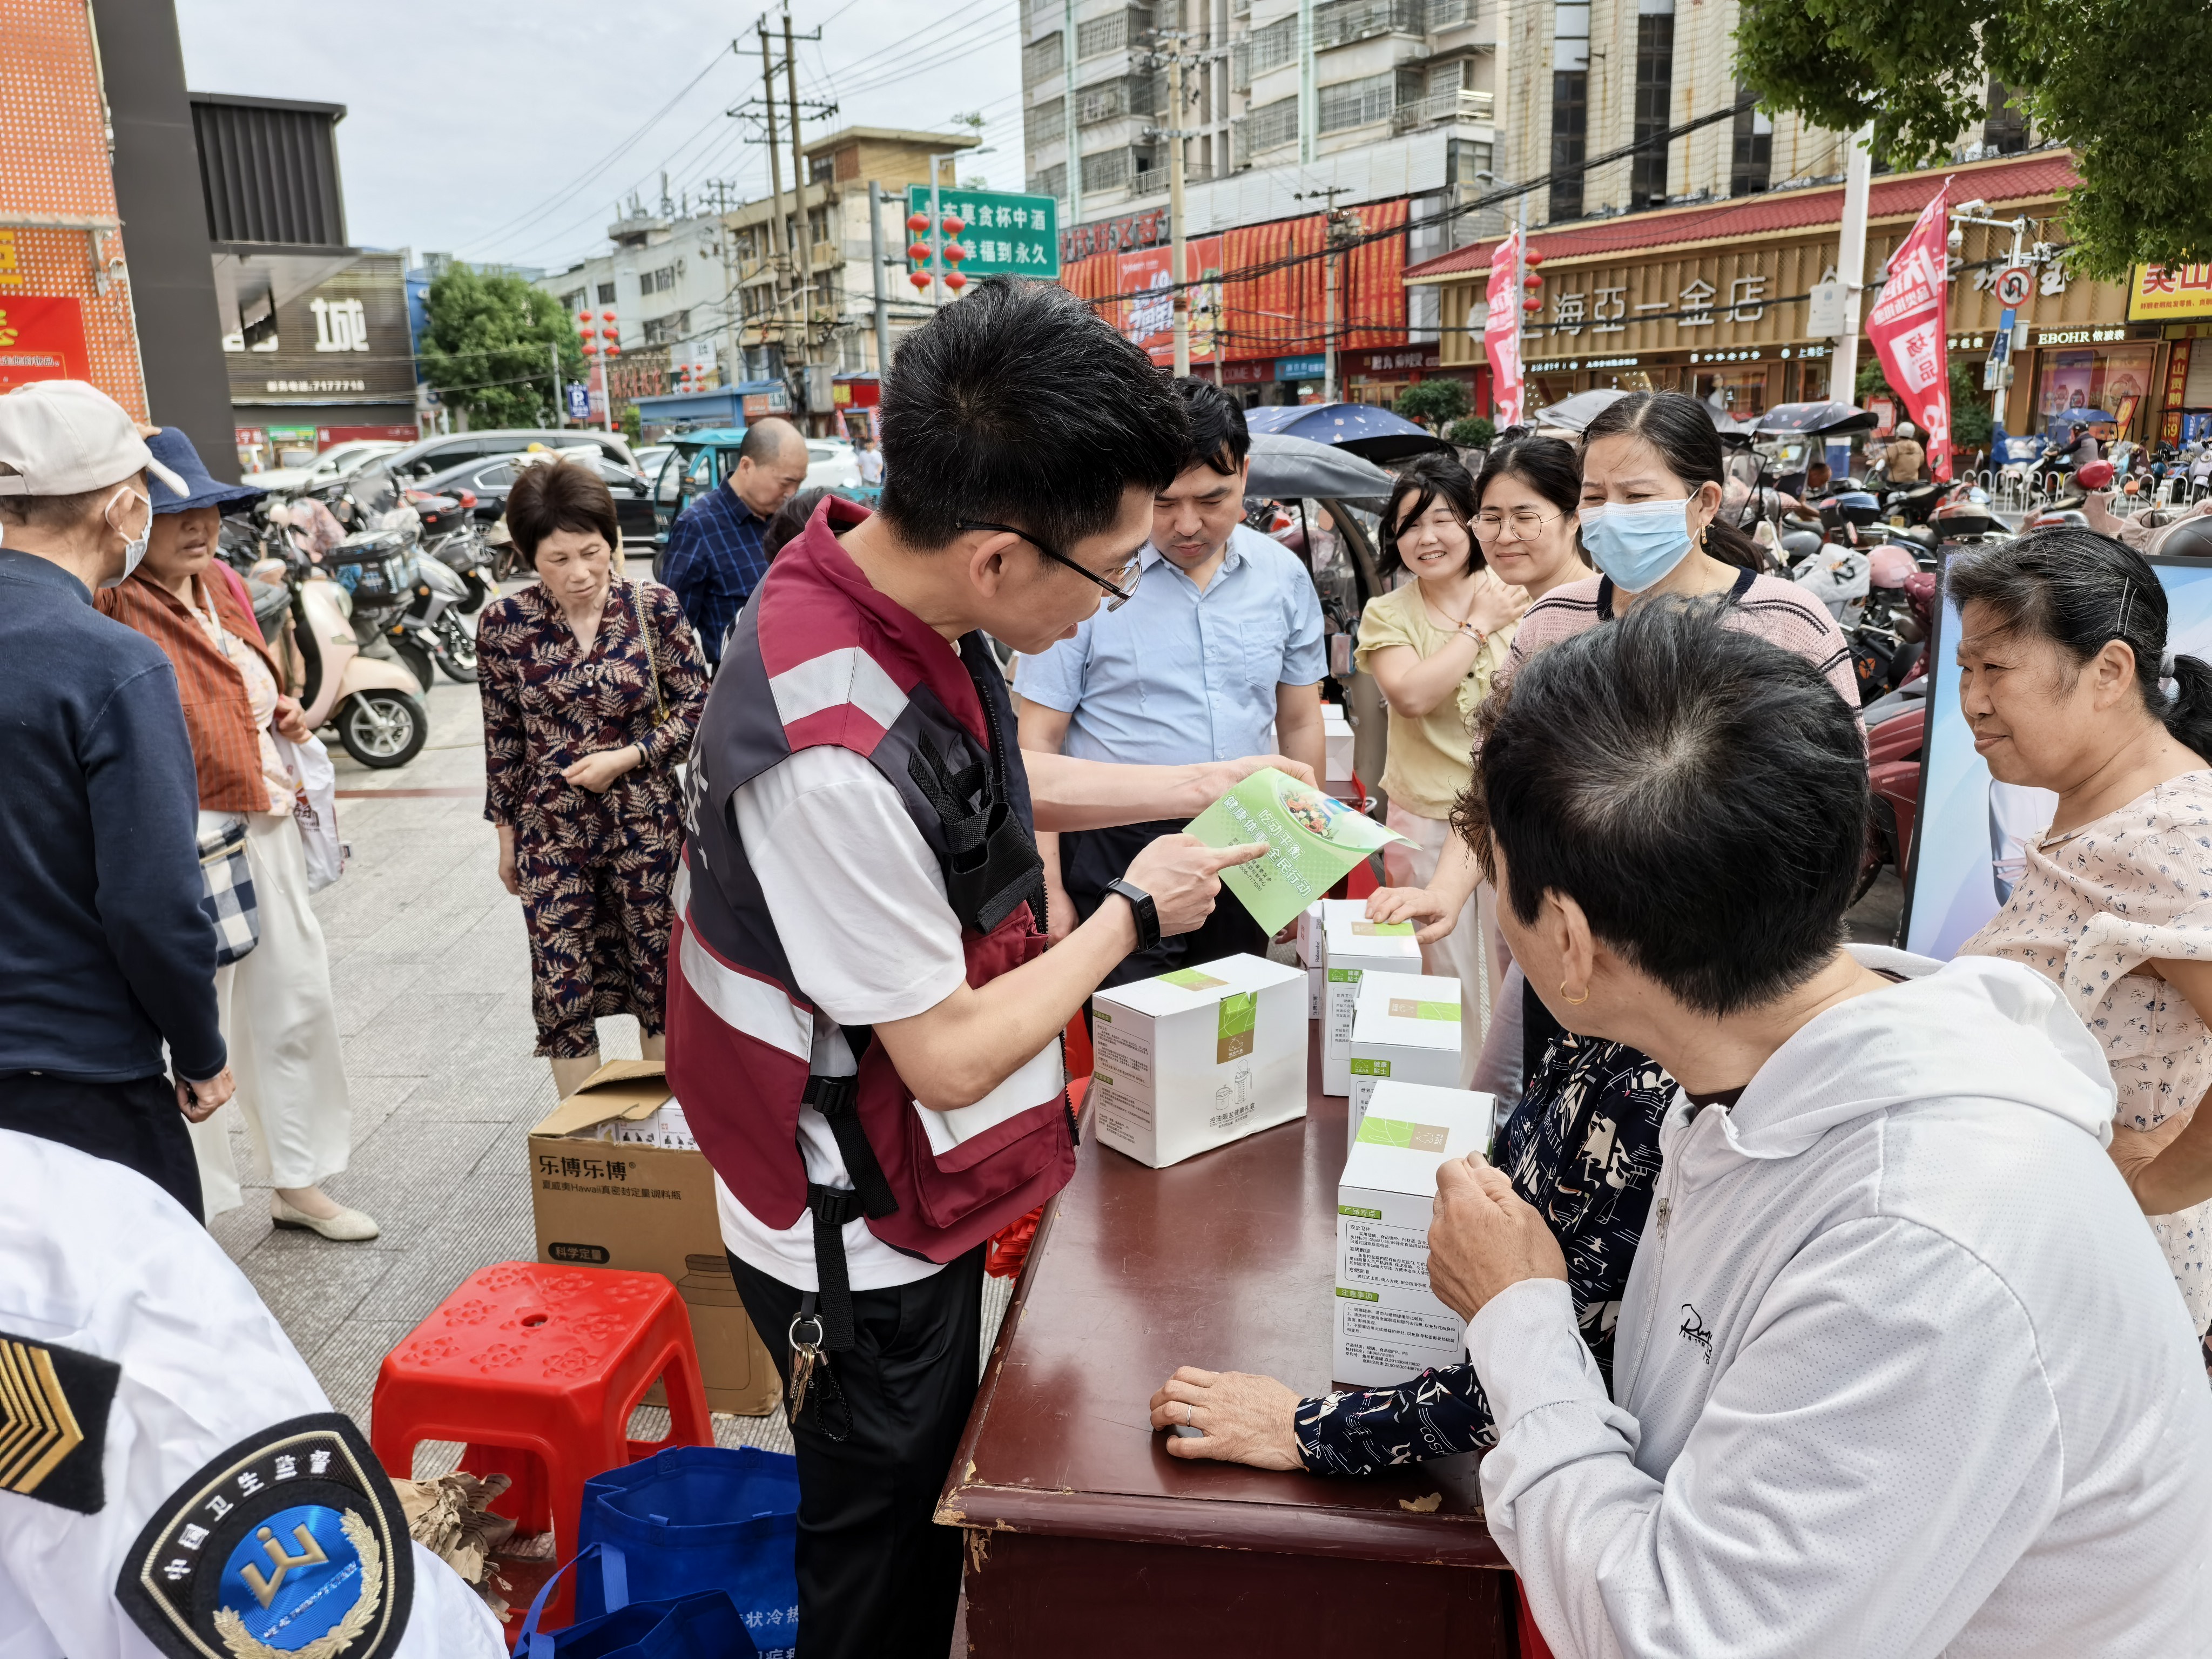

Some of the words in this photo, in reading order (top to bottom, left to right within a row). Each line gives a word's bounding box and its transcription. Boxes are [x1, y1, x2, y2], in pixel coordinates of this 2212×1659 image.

[948, 239, 1047, 265] 幸福到永久
[309, 298, 369, 352] 城
[2038, 332, 2090, 345] EBOHR
[1222, 794, 1270, 843] 健康体重
[1266, 846, 1313, 898] 全民行动
[1257, 807, 1305, 860] 吃动平衡
[1238, 865, 1262, 891] 0556-7171200
[1210, 1102, 1255, 1125] 控油限盐健康礼盒
[539, 1155, 627, 1182] 乐博乐博
[542, 1179, 682, 1201] 夏威夷Hawaii真密封定量调料瓶
[1345, 1206, 1377, 1217] 产品特点
[555, 1246, 602, 1262] 科学定量
[1341, 1289, 1373, 1300] 注意事项
[164, 1449, 332, 1580] 中国卫生监督
[739, 1604, 799, 1629] 状冷热
